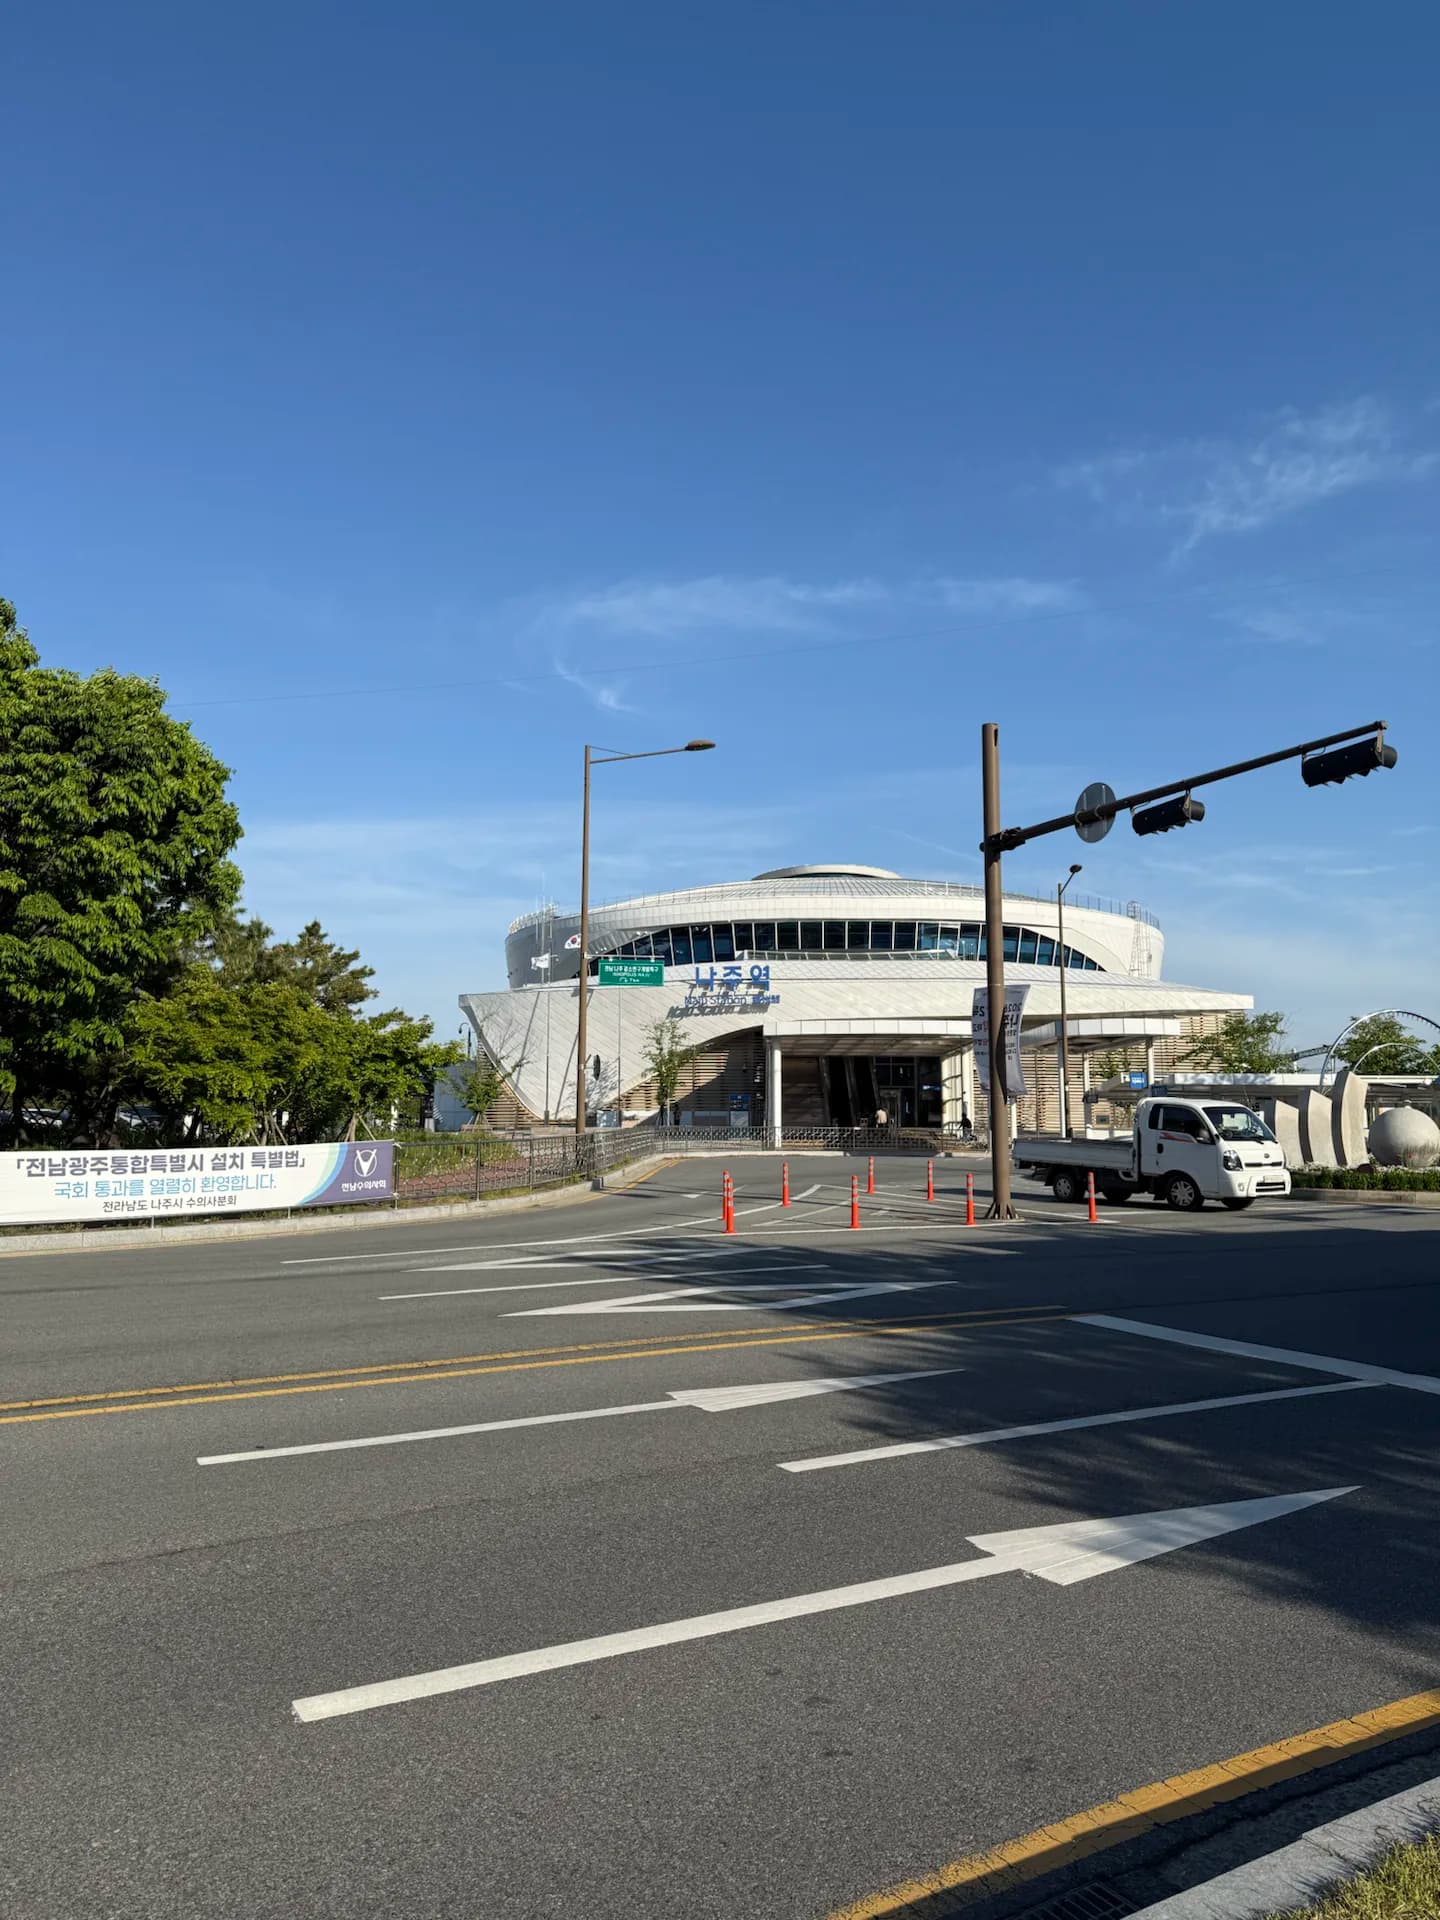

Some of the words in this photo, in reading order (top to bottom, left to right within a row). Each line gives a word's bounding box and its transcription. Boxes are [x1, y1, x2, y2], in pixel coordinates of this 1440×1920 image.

[695, 965, 770, 992] 나주역
[685, 995, 708, 1006] Naju
[710, 995, 747, 1005] Station
[17, 1154, 204, 1178] 「전남광주통합특별시
[211, 1152, 245, 1171] 설치
[251, 1150, 305, 1169] 특별법」
[54, 1181, 88, 1199] 국회
[95, 1179, 144, 1197] 통과를
[150, 1177, 196, 1196] 열렬히
[201, 1173, 277, 1193] 환영합니다.
[102, 1199, 148, 1213] 전라남도
[151, 1197, 183, 1210] 나주시
[186, 1195, 237, 1208] 수의사분회
